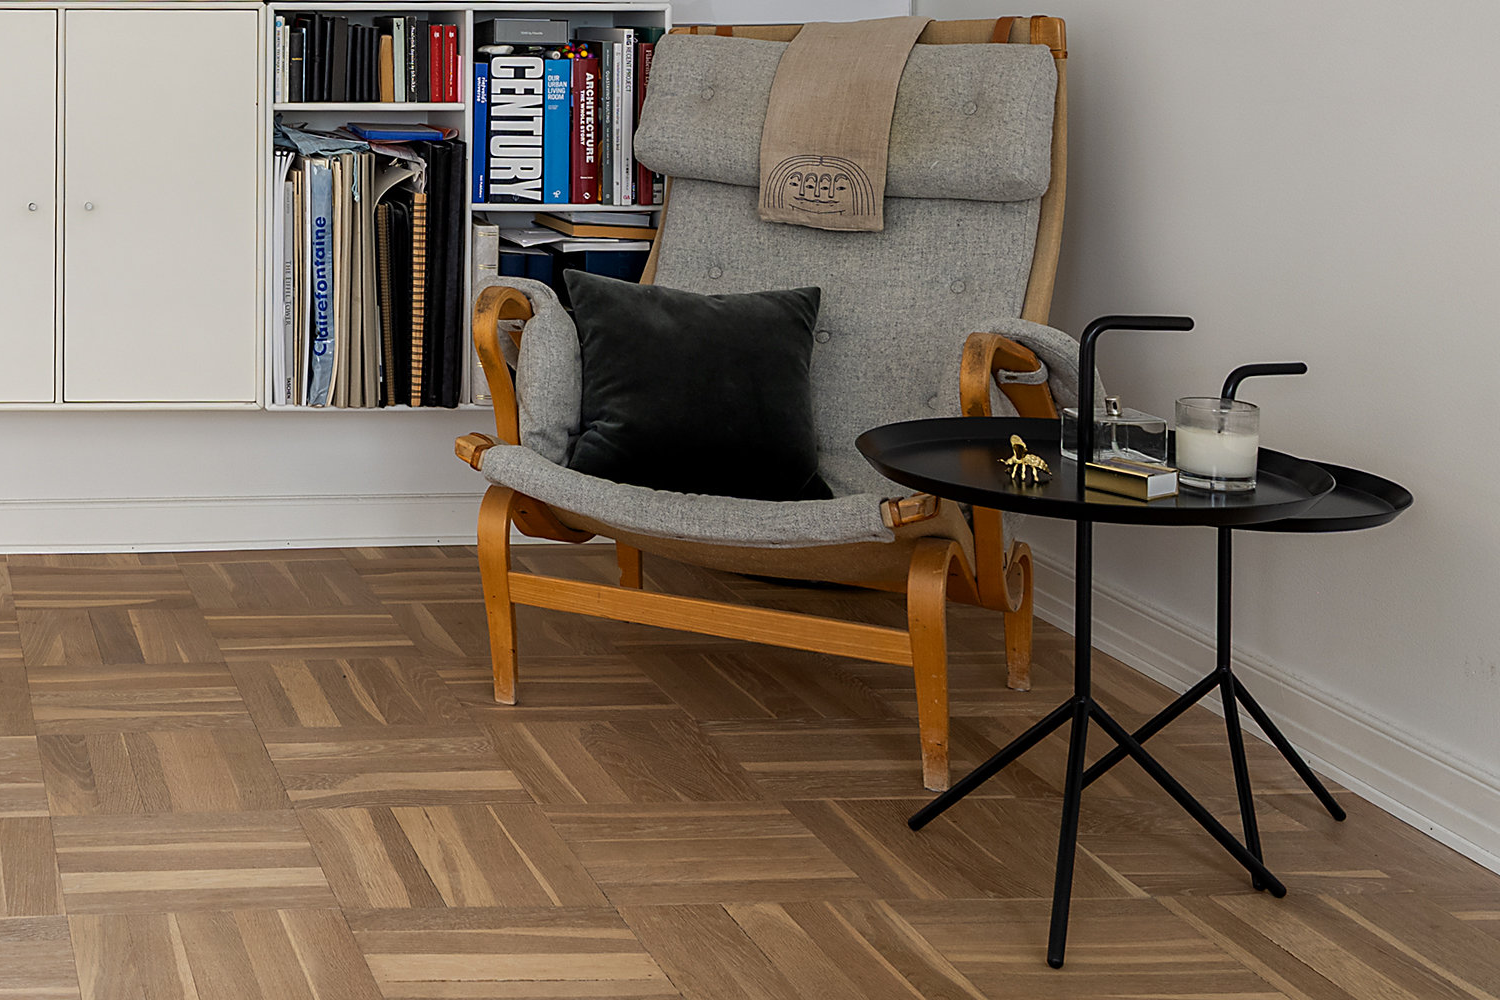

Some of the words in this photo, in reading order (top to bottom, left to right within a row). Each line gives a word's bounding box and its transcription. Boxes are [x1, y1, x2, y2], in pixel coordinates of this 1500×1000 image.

[490, 56, 544, 200] CENTURY
[586, 72, 594, 163] ARCHITECTURE
[313, 216, 328, 356] Clairefontaine
